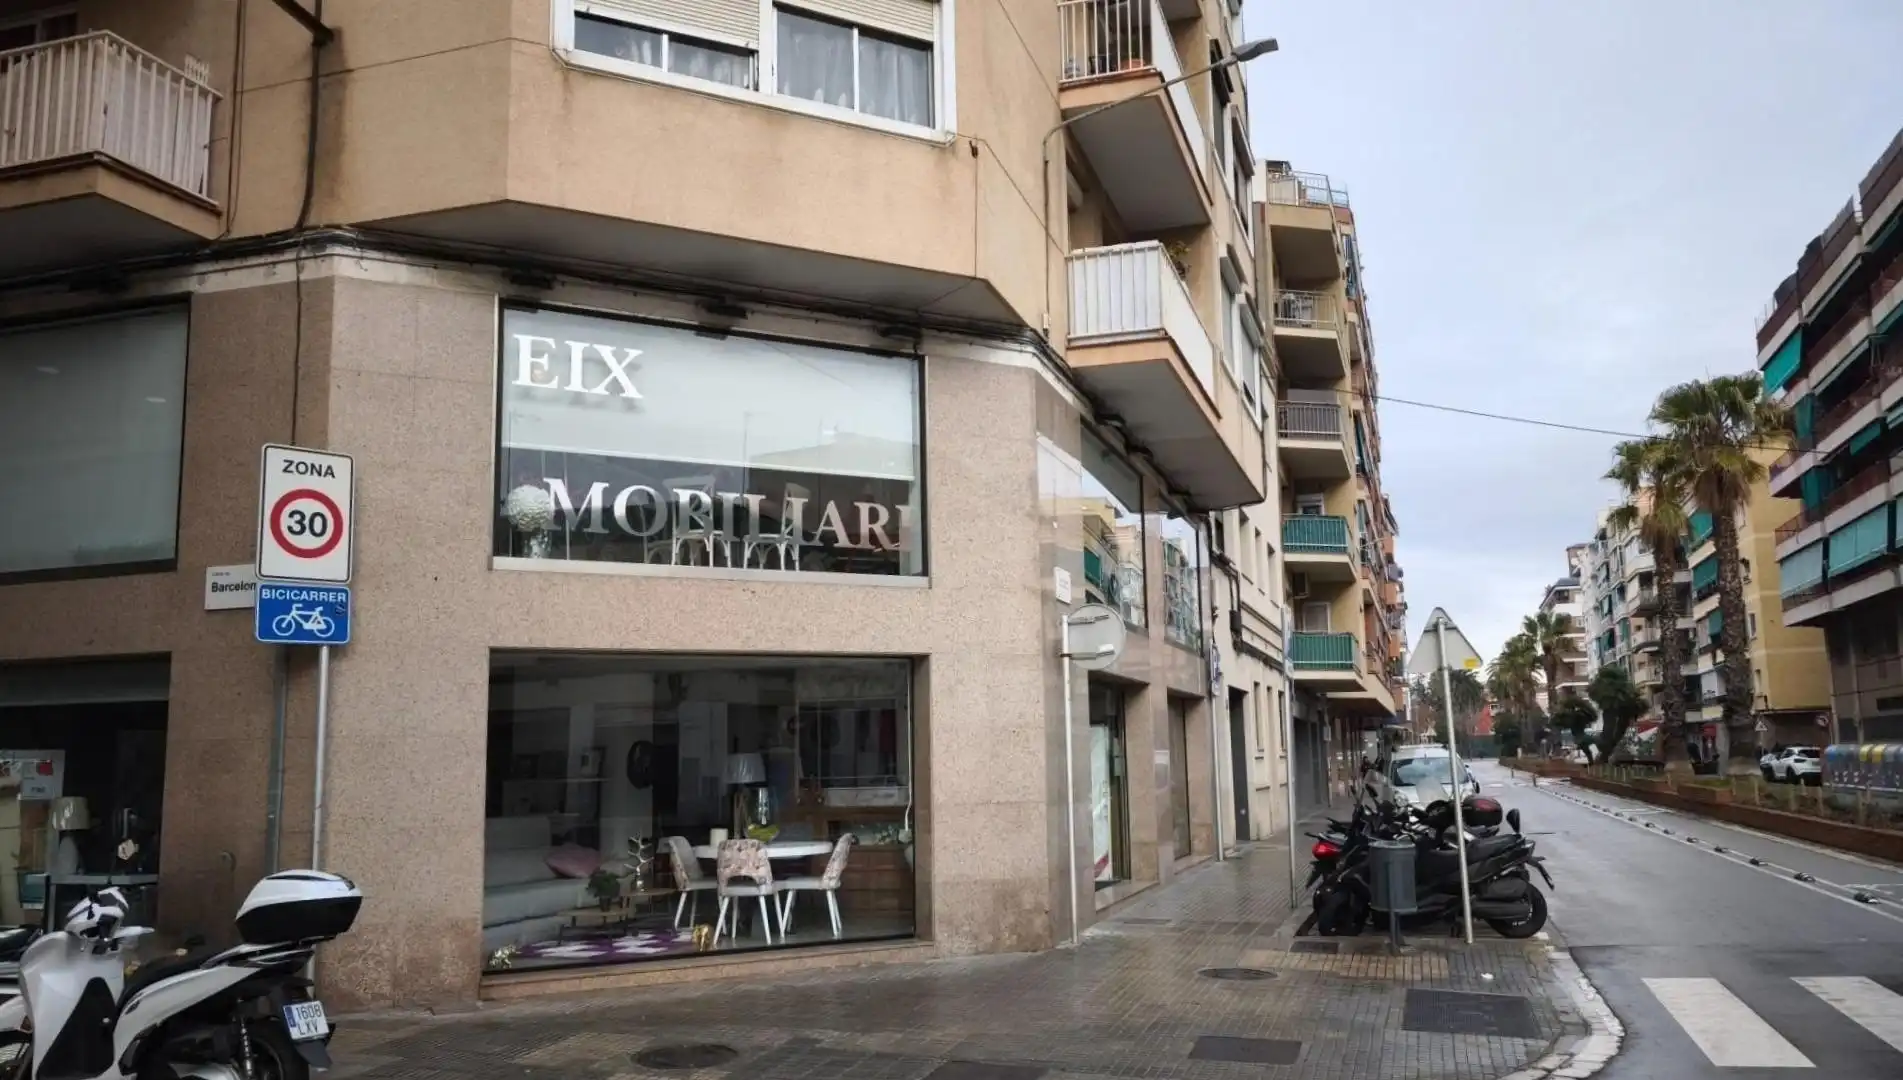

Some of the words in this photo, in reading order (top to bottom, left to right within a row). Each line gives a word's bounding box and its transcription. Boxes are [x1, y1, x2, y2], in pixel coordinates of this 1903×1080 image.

[512, 334, 644, 398] EIX
[282, 459, 336, 478] ZONA
[287, 509, 328, 537] 30
[262, 589, 346, 602] BICICARRER
[296, 1004, 322, 1019] 1608
